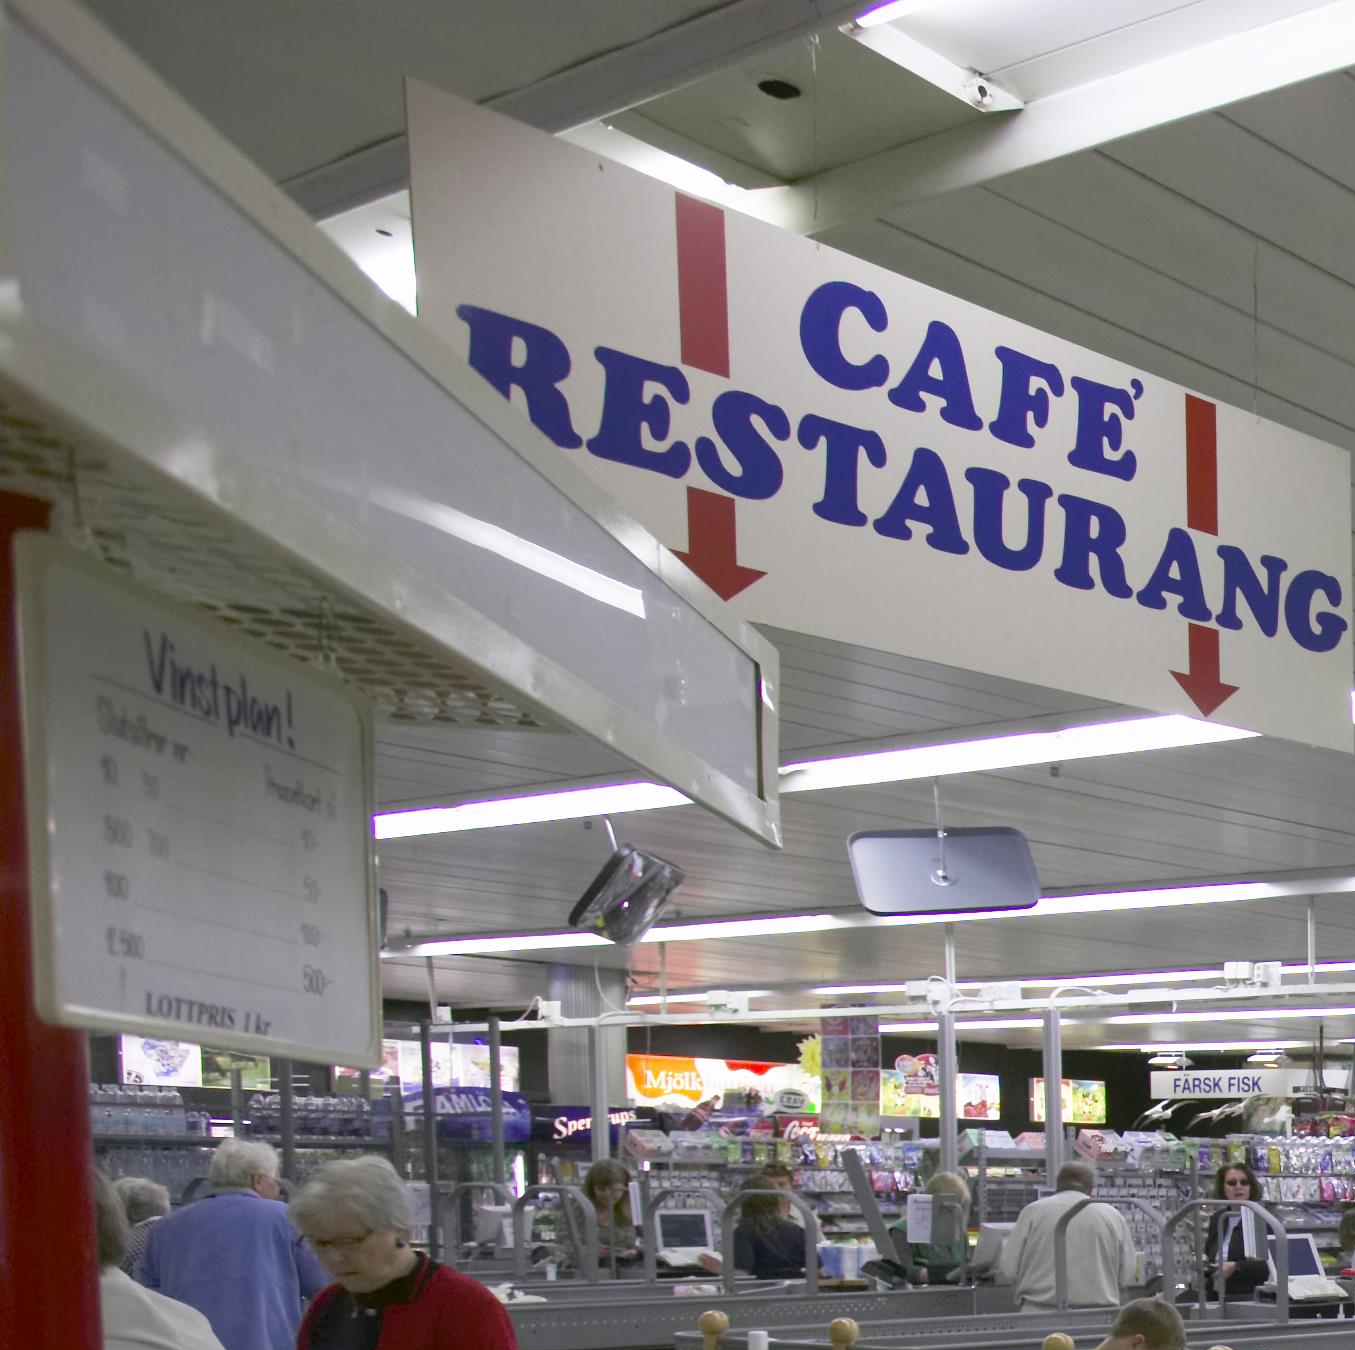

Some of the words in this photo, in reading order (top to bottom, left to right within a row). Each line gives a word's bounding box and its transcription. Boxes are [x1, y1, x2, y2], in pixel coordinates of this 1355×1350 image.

[456, 303, 1348, 652] RESTAURANG
[142, 627, 296, 750] Vinstplan!
[145, 991, 237, 1030] LOTTPRIS
[1173, 1073, 1223, 1094] FÄRSK
[1228, 1076, 1262, 1093] FISK
